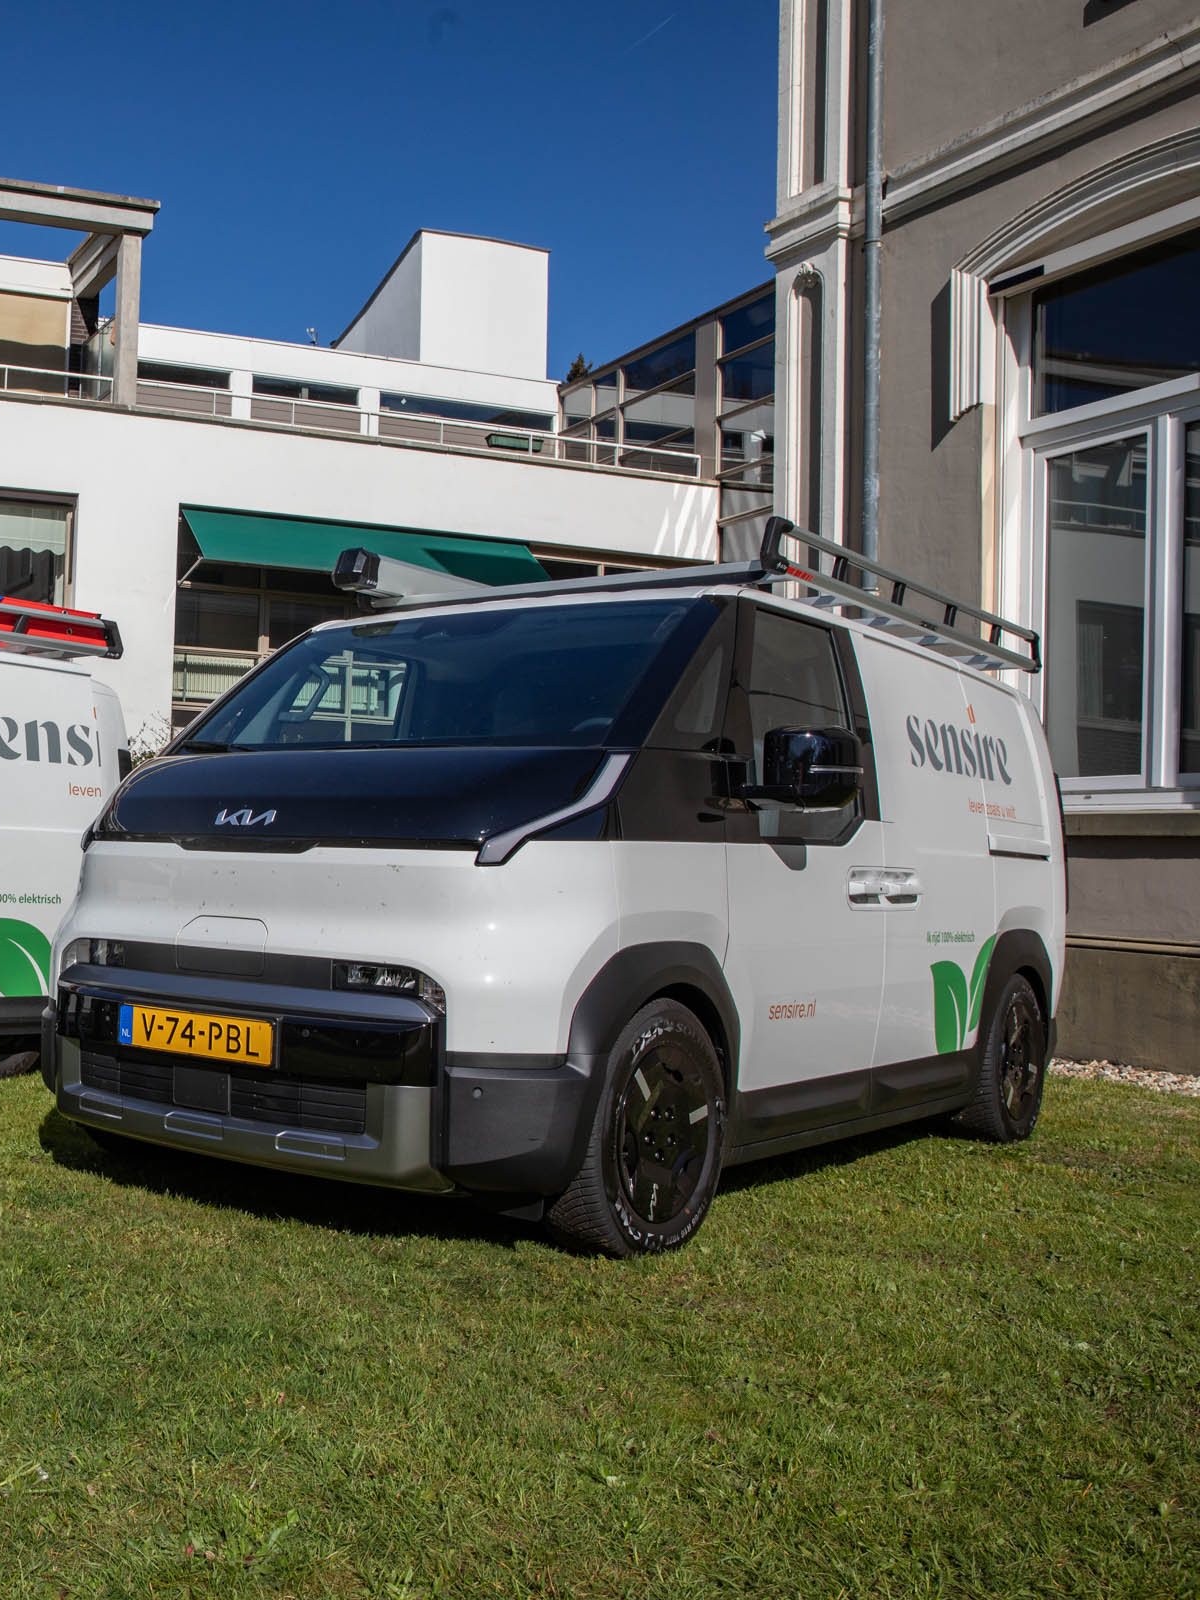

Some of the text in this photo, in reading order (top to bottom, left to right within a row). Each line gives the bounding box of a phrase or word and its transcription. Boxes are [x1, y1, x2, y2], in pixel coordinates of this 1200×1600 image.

[906, 704, 1012, 785] sensire
[68, 782, 101, 797] leven
[215, 808, 277, 826] KIA
[18, 893, 62, 904] elektrisch
[768, 998, 817, 1020] sensire.nl
[121, 1028, 131, 1038] NL
[142, 1013, 260, 1057] V-74-PBL
